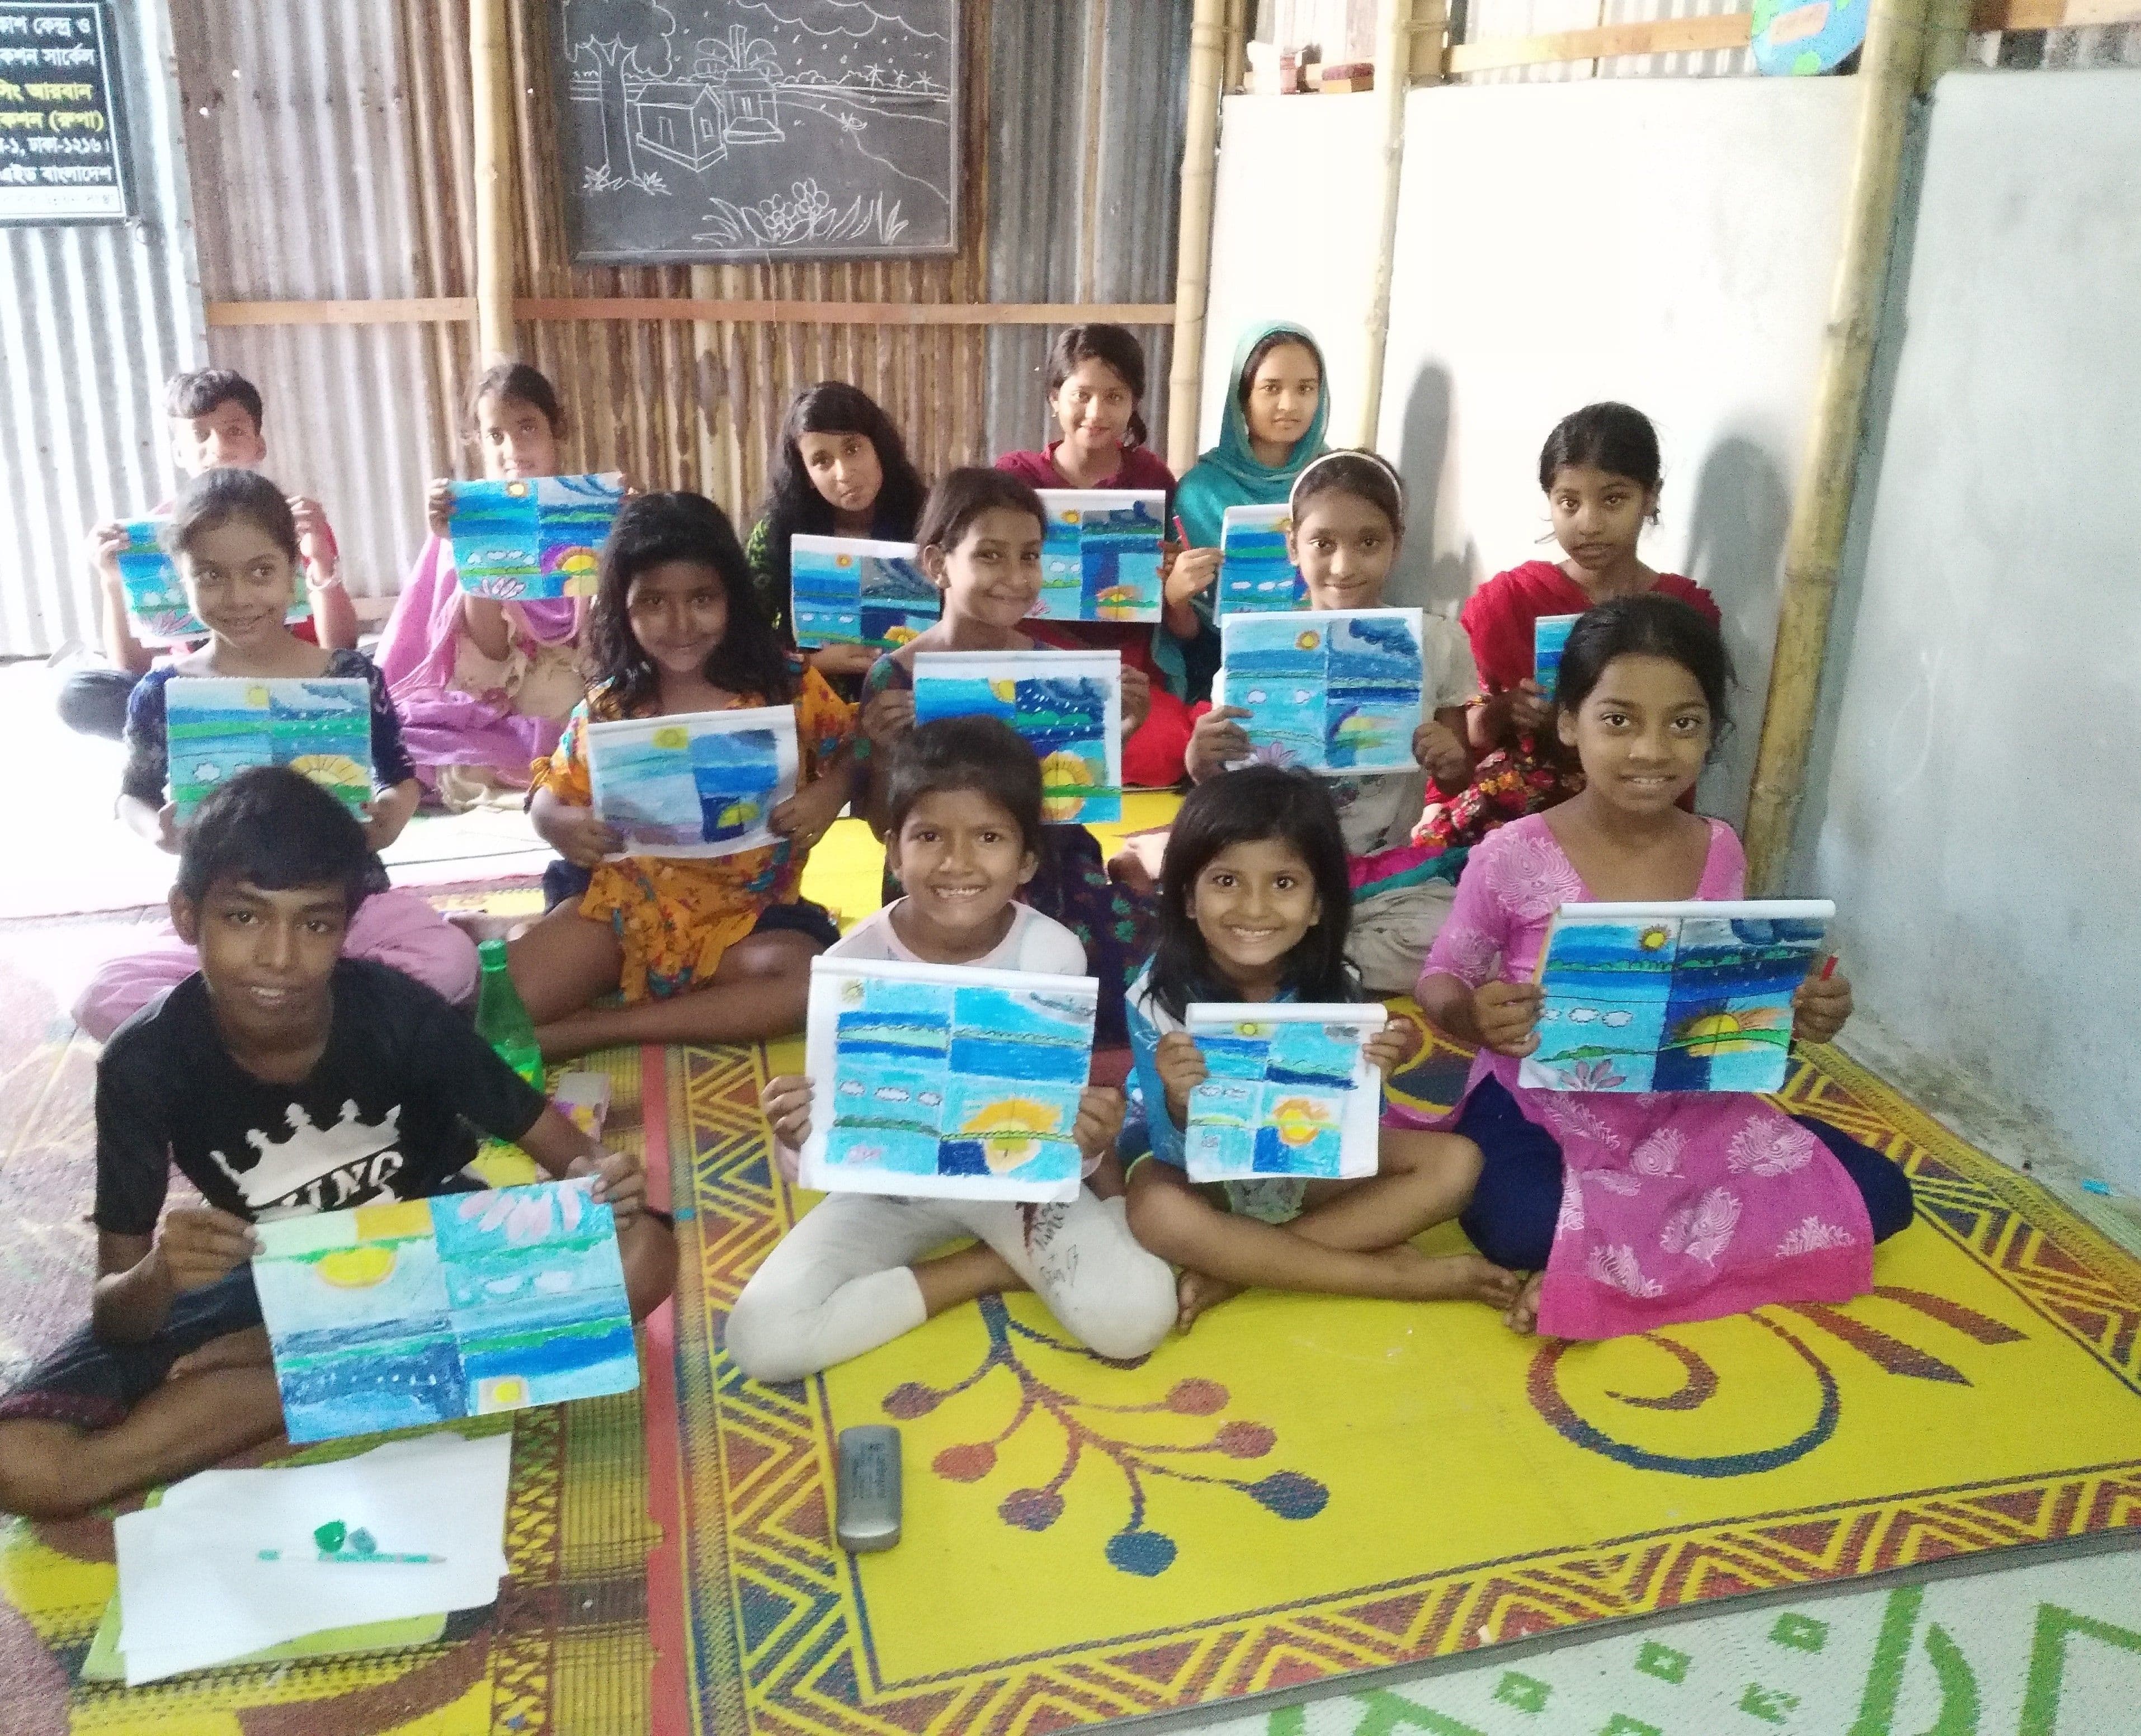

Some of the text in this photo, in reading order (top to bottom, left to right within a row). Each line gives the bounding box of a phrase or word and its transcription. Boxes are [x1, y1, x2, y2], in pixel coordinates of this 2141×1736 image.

[34, 17, 72, 37] কেন্দ্র
[76, 18, 91, 34] ও
[41, 43, 95, 66] সার্কেল
[24, 82, 93, 100] আরবান
[40, 165, 112, 183] বাংলাদেশ
[280, 1150, 404, 1209] ING
